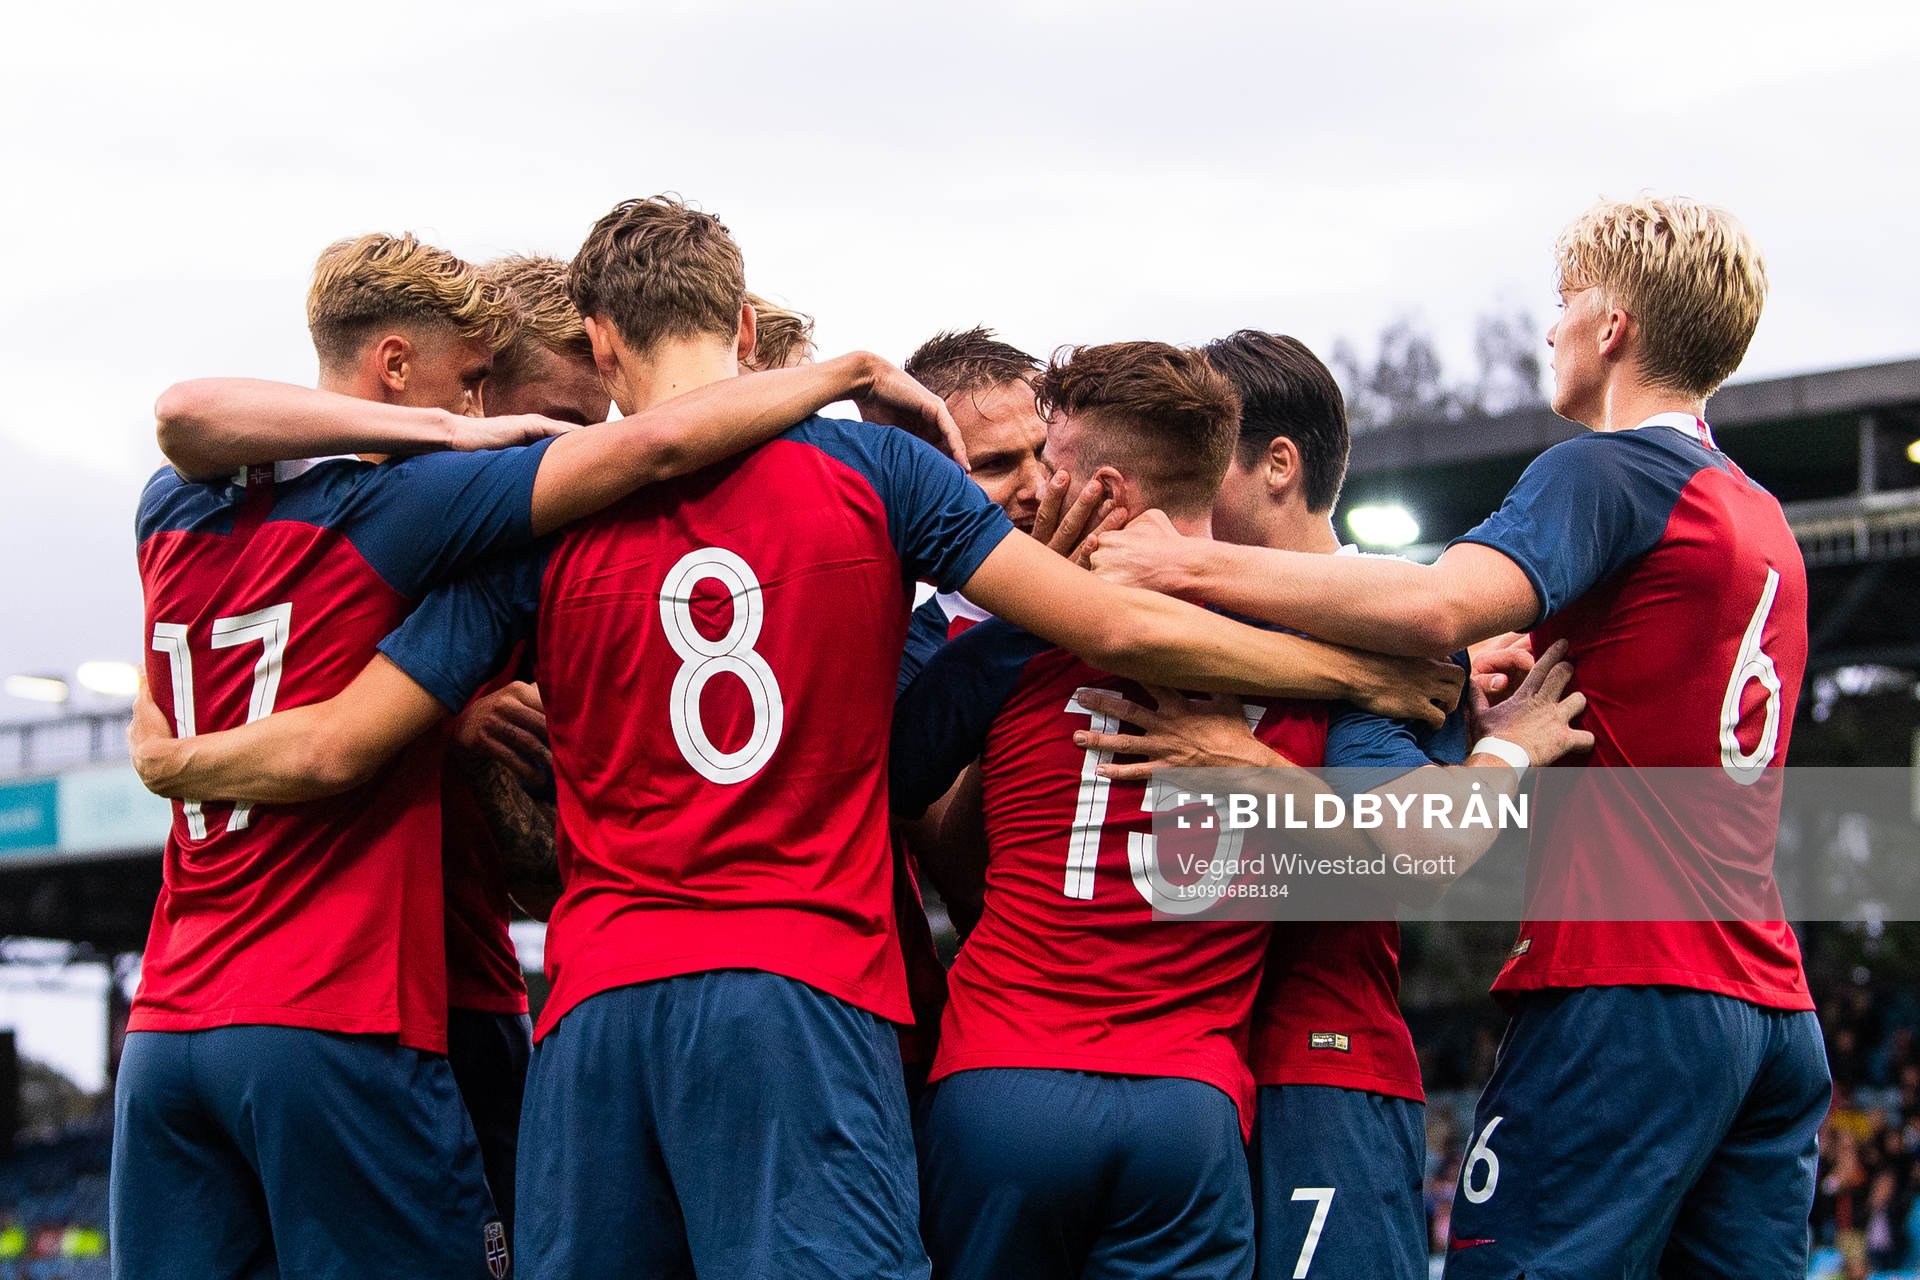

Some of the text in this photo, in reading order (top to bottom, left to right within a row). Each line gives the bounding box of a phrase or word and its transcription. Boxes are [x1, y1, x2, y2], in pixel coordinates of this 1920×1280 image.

[152, 602, 293, 840] 17
[660, 547, 783, 784] 8
[1720, 567, 1781, 785] 6
[1291, 1188, 1336, 1279] 7
[1463, 1116, 1503, 1204] 6
